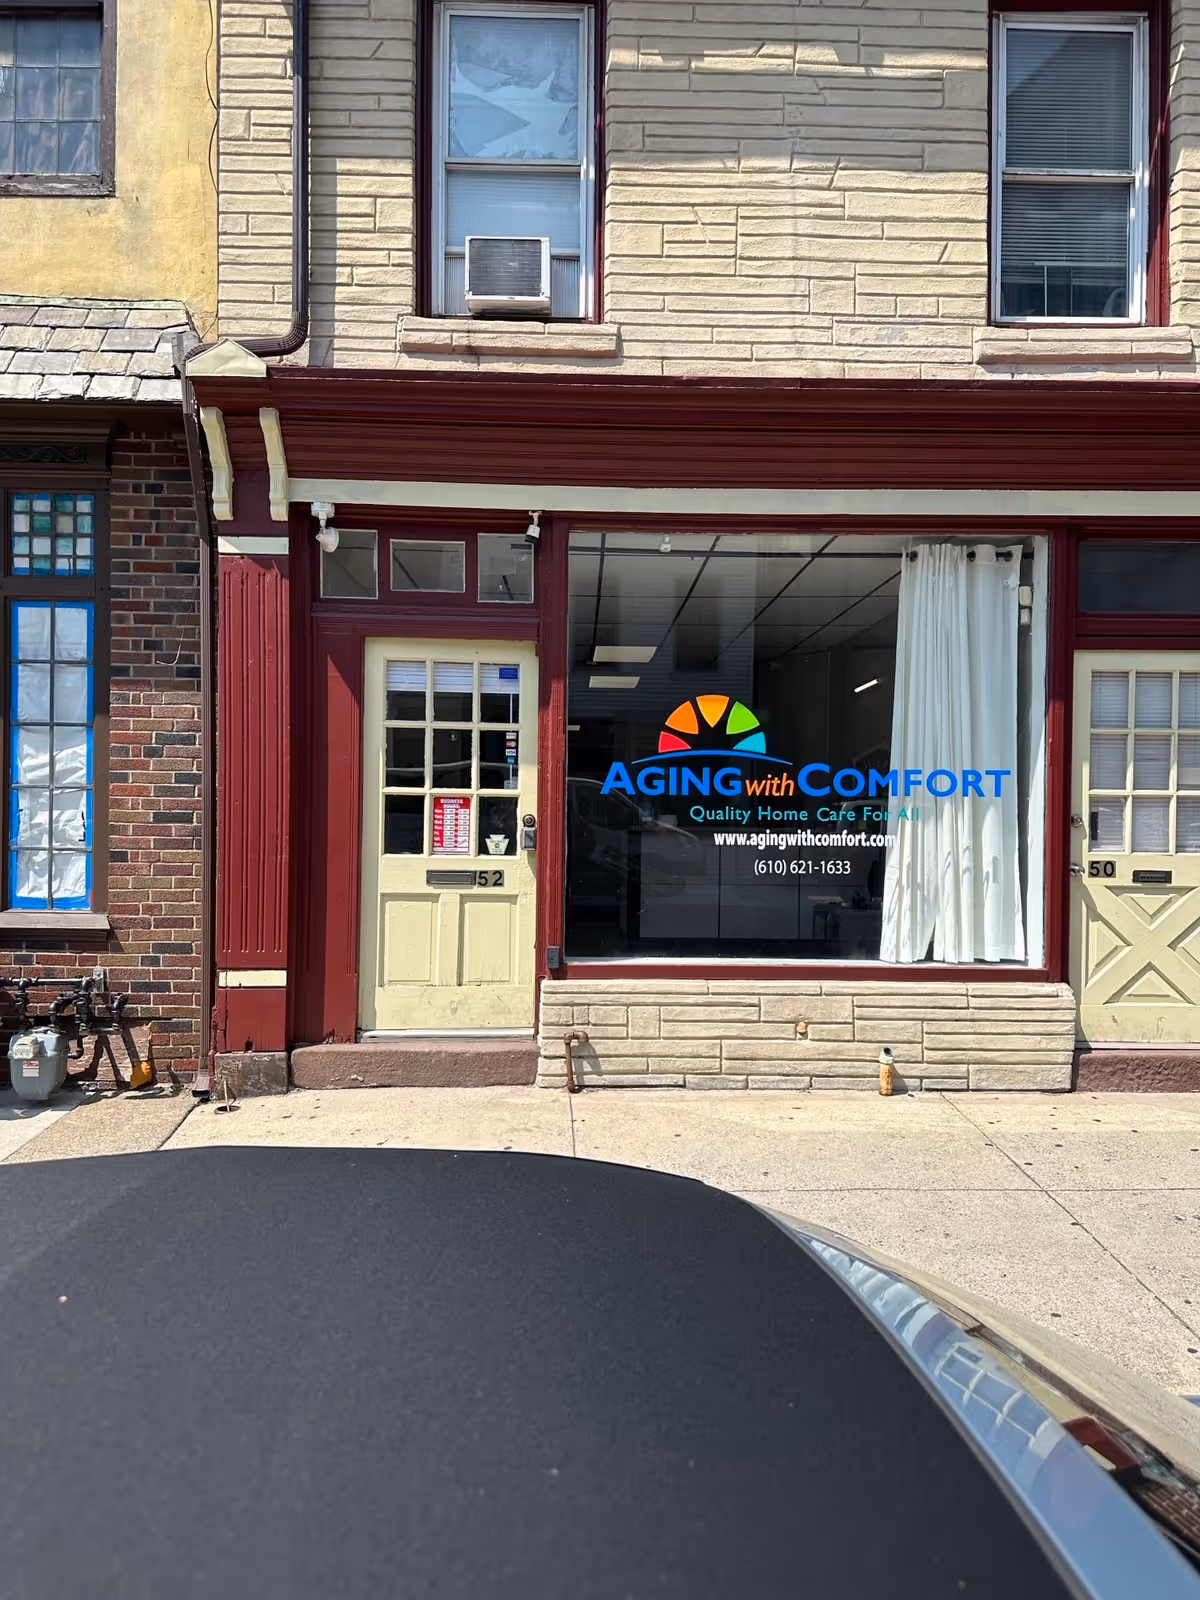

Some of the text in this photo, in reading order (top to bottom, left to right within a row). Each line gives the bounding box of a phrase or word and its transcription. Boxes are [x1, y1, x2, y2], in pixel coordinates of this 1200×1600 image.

[600, 762, 1011, 798] AGING with COMFORT
[690, 805, 920, 825] Quality Home Care For All
[714, 829, 898, 850] www.agingwithcomfort.com
[754, 859, 851, 876] (610) 621-1633
[1089, 861, 1115, 877] 50
[477, 870, 503, 886] 52
